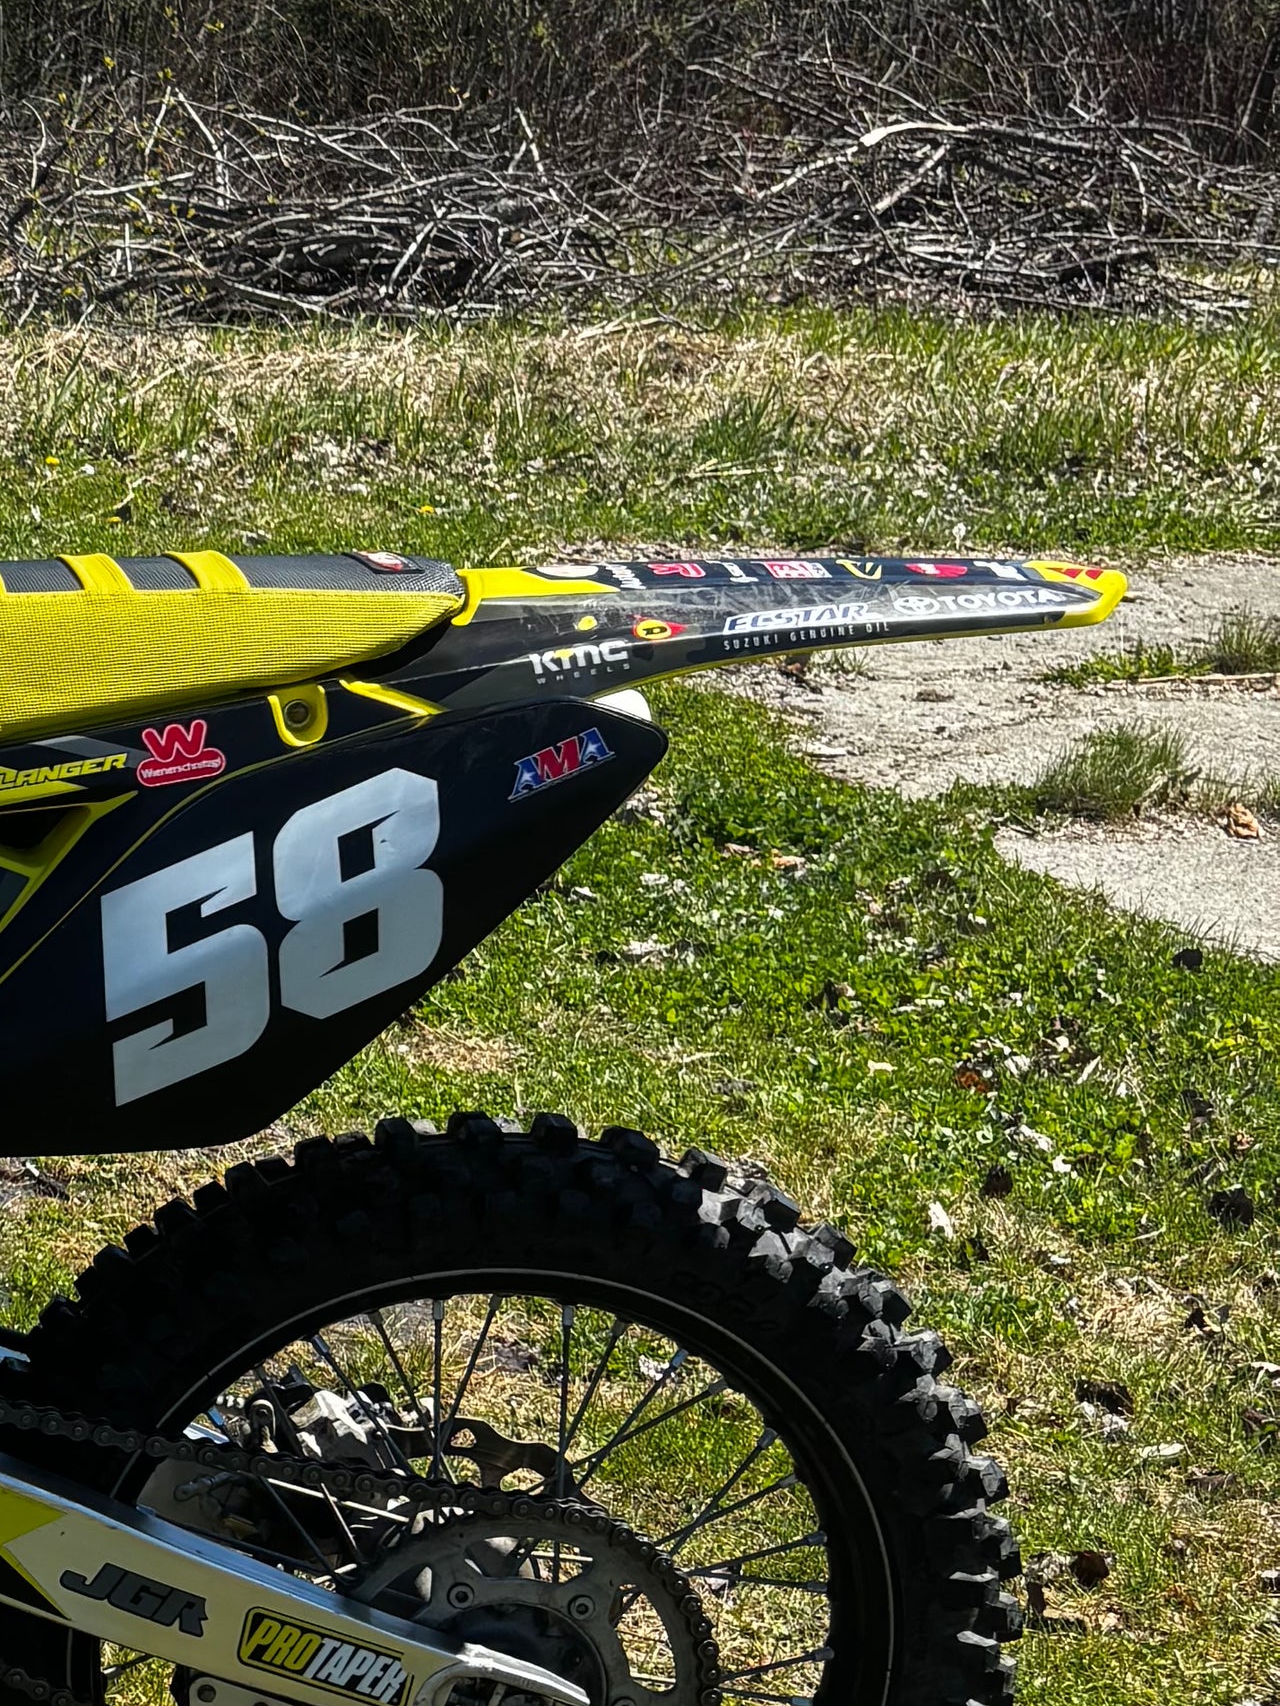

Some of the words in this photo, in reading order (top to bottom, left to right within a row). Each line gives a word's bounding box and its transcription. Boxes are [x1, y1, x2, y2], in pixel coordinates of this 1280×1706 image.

[937, 588, 1061, 612] TOYOTA
[723, 602, 883, 636] ECSTAR
[723, 635, 779, 651] SUZUKI
[790, 624, 855, 642] GENUINE
[866, 621, 891, 634] OIL
[536, 663, 630, 685] WHEELS
[507, 726, 616, 801] AMA
[100, 766, 444, 1108] 58
[59, 1562, 209, 1638] JGR
